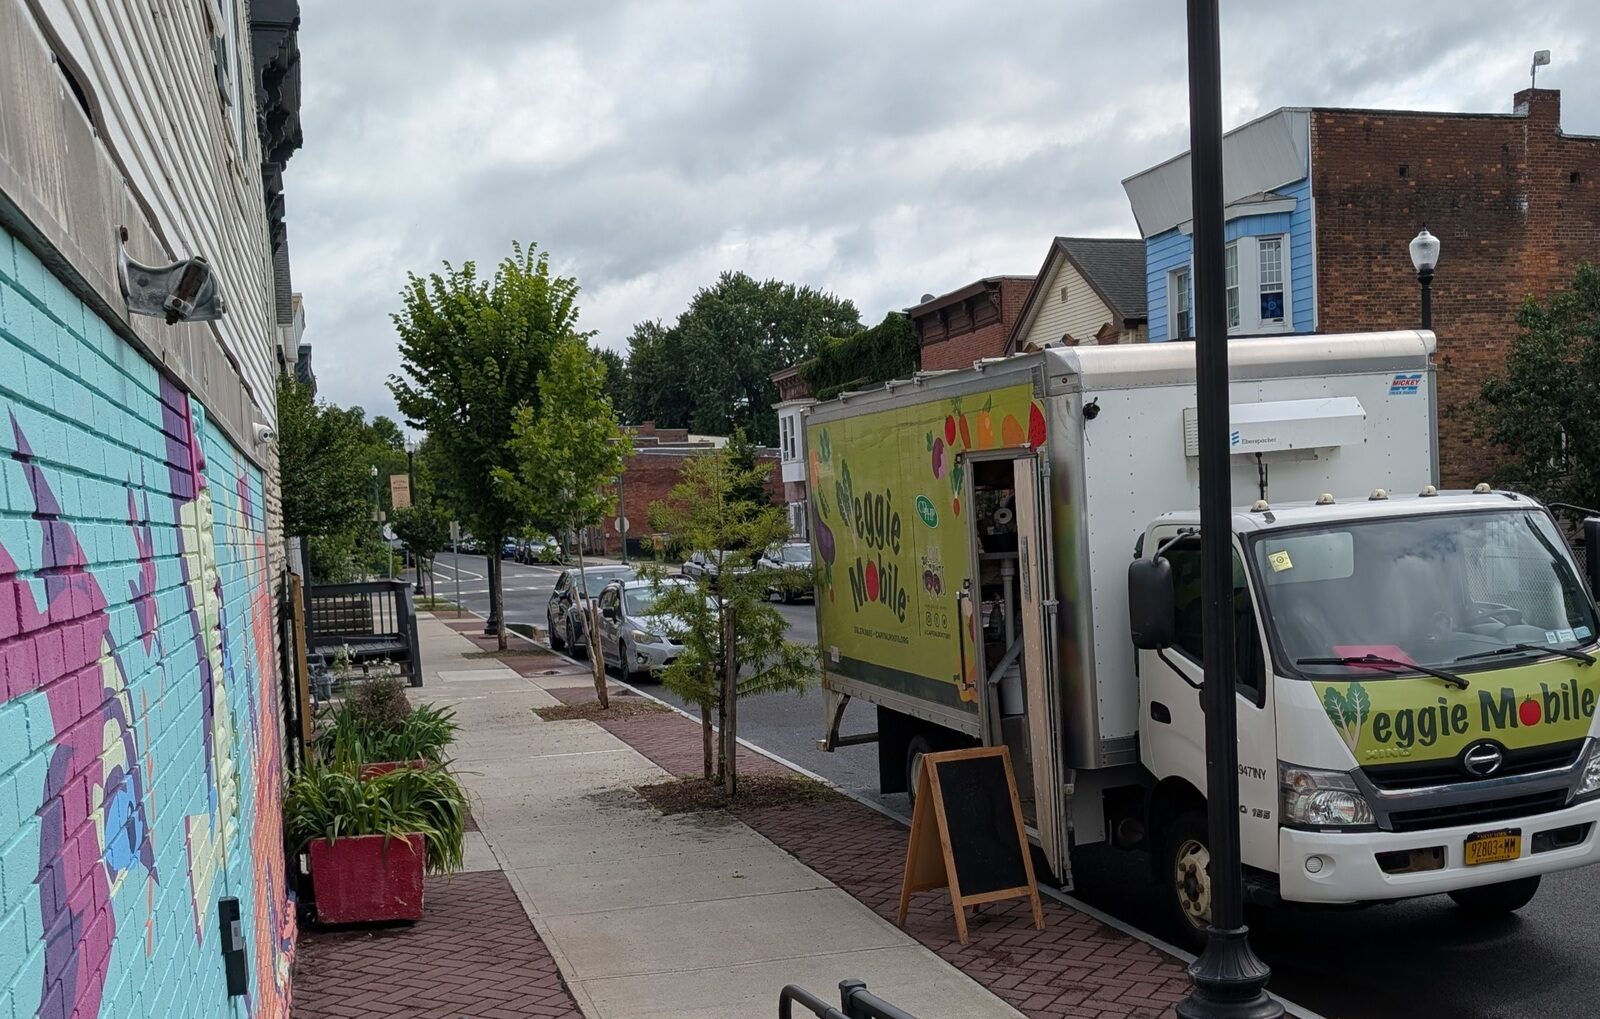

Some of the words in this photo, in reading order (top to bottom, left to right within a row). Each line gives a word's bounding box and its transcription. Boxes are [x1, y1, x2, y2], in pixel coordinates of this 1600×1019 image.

[1478, 679, 1595, 732] Mobile
[1238, 763, 1267, 780] 9471NY
[1251, 807, 1271, 820] 155
